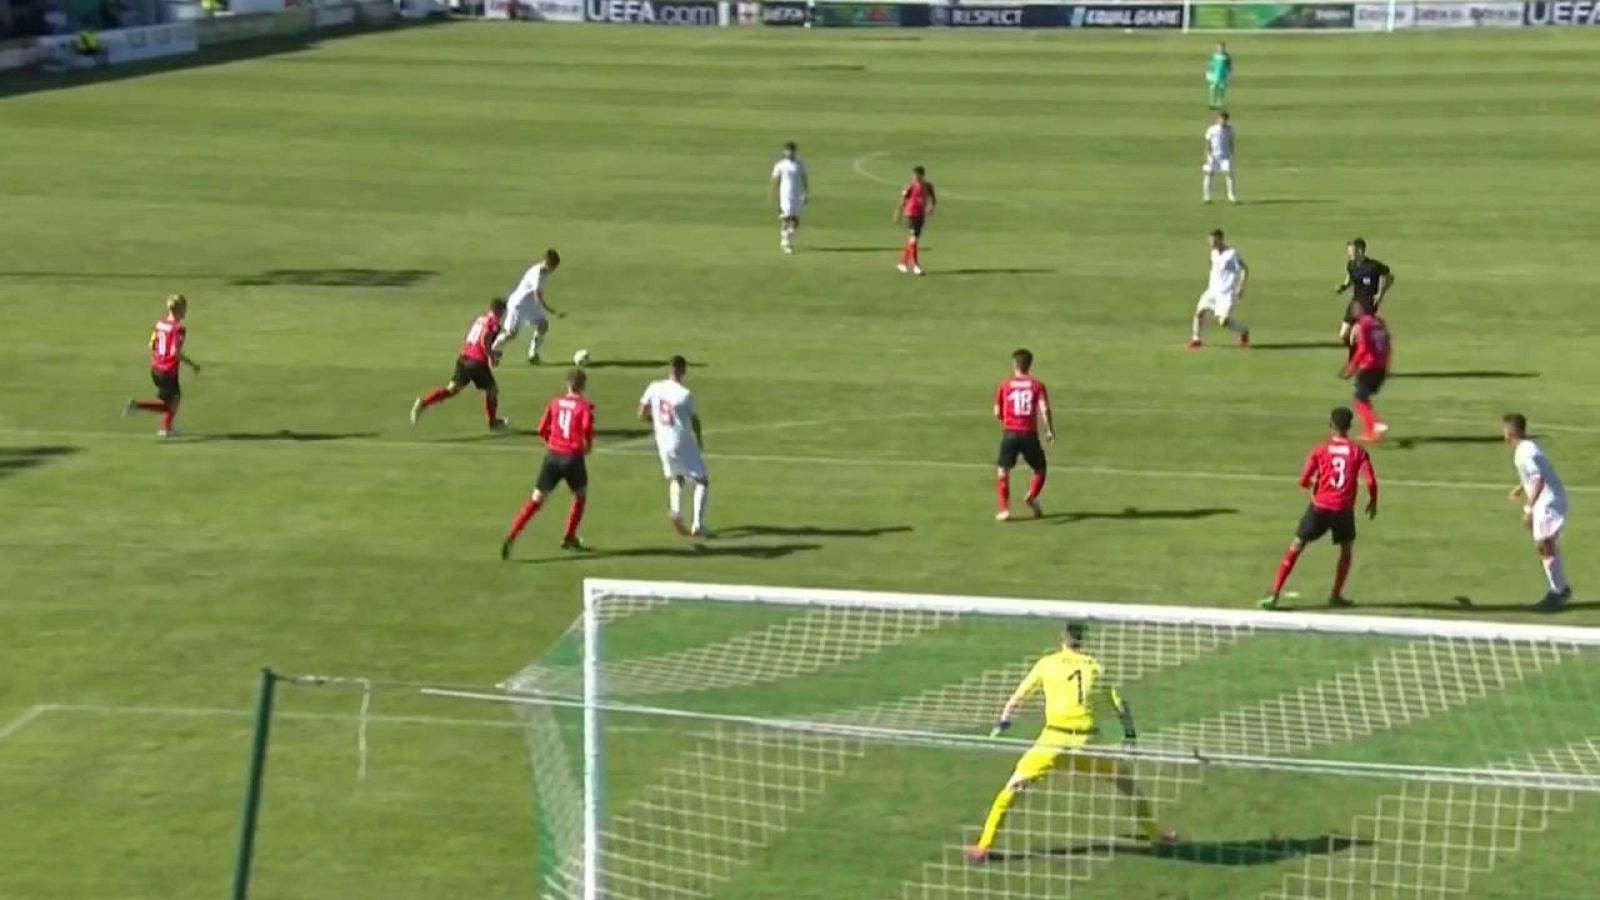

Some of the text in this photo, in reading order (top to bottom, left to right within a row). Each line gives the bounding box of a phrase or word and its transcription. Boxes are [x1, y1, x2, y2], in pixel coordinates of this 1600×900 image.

[587, 0, 717, 24] UEFA.com
[953, 9, 1023, 25] RESPECT
[1134, 9, 1180, 25] GAME
[1007, 389, 1033, 416] 18
[557, 409, 573, 440] 4
[1329, 456, 1346, 489] 3
[1067, 669, 1083, 704] 1
